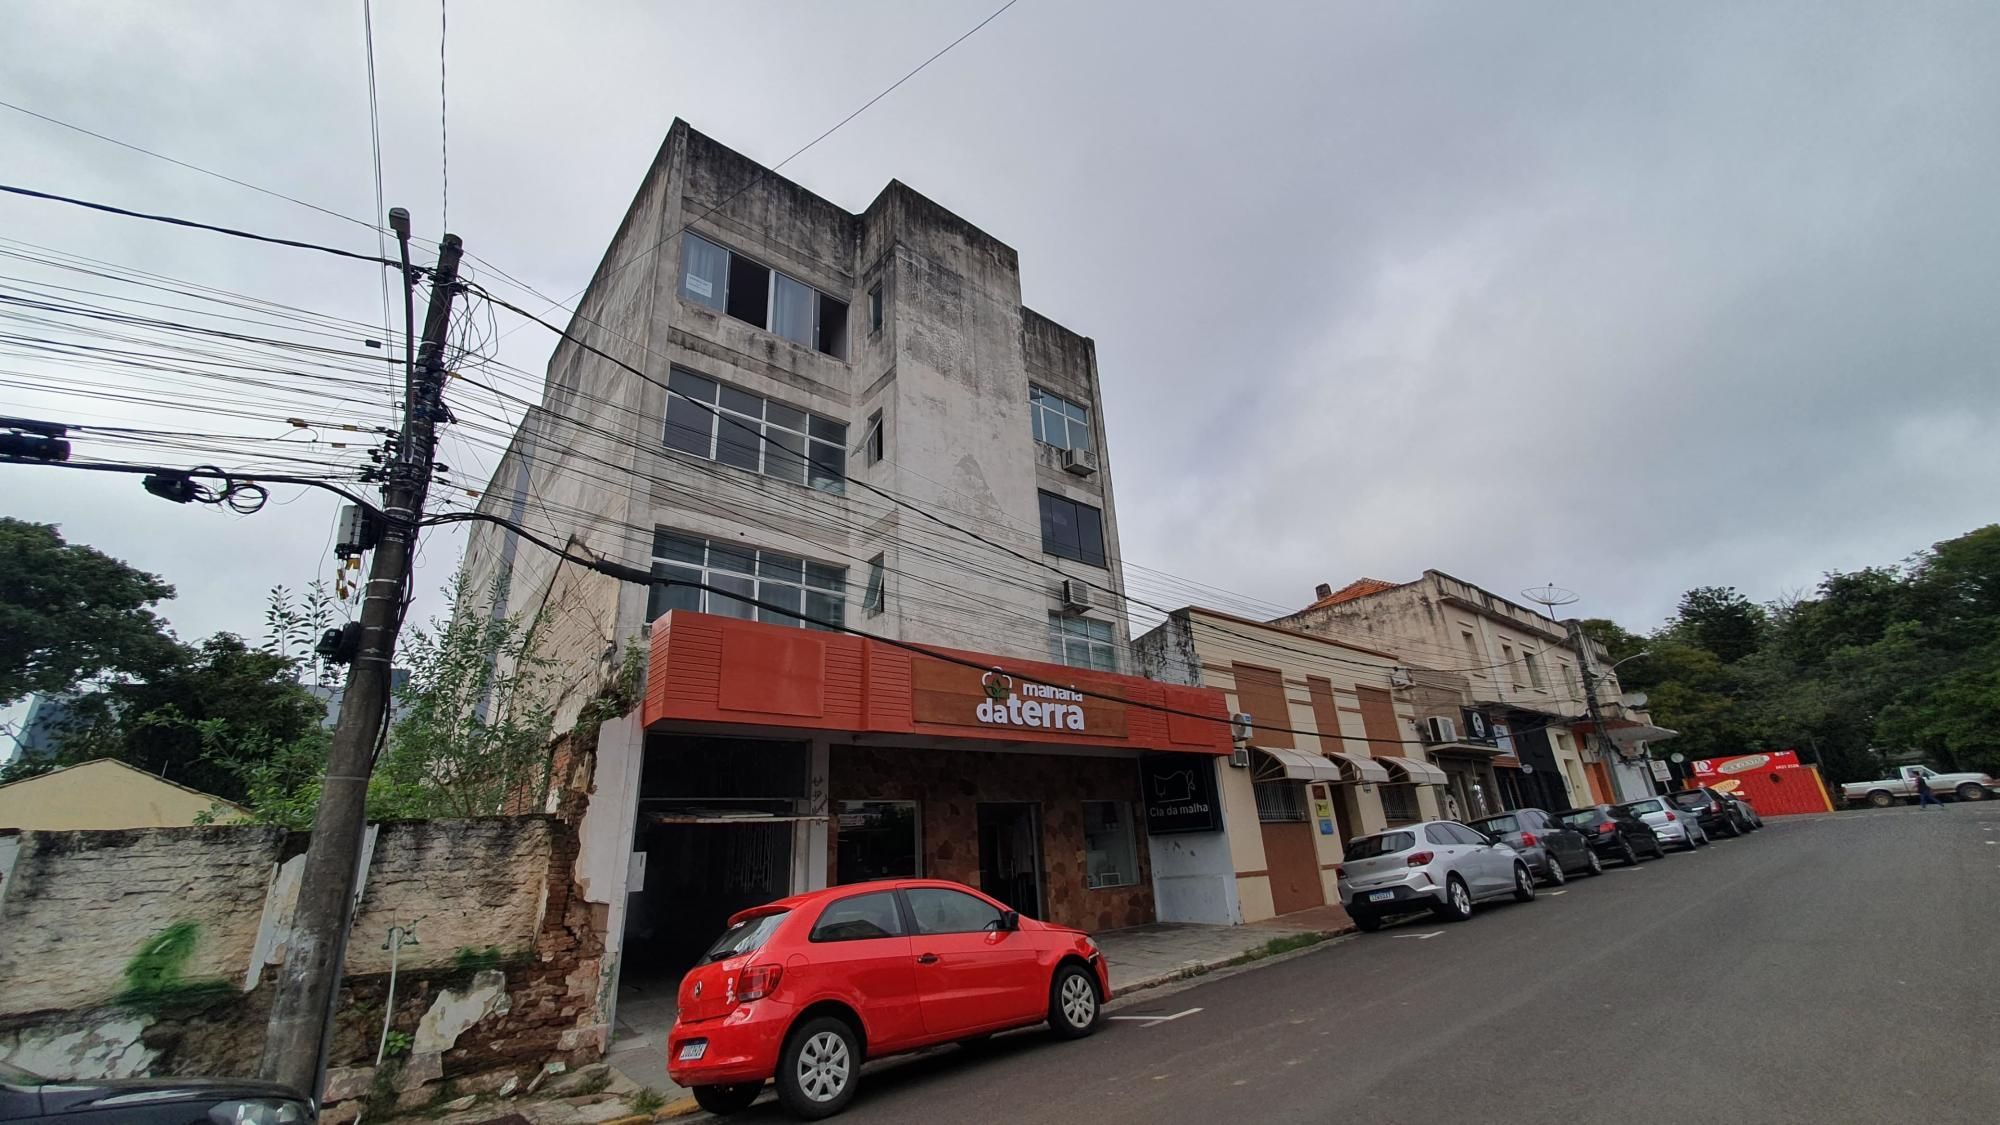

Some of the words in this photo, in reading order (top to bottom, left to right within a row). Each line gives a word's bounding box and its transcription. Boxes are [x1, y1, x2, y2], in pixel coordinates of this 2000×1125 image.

[1150, 807, 1164, 816] Cia
[1166, 805, 1177, 815] da
[1180, 803, 1208, 814] malha
